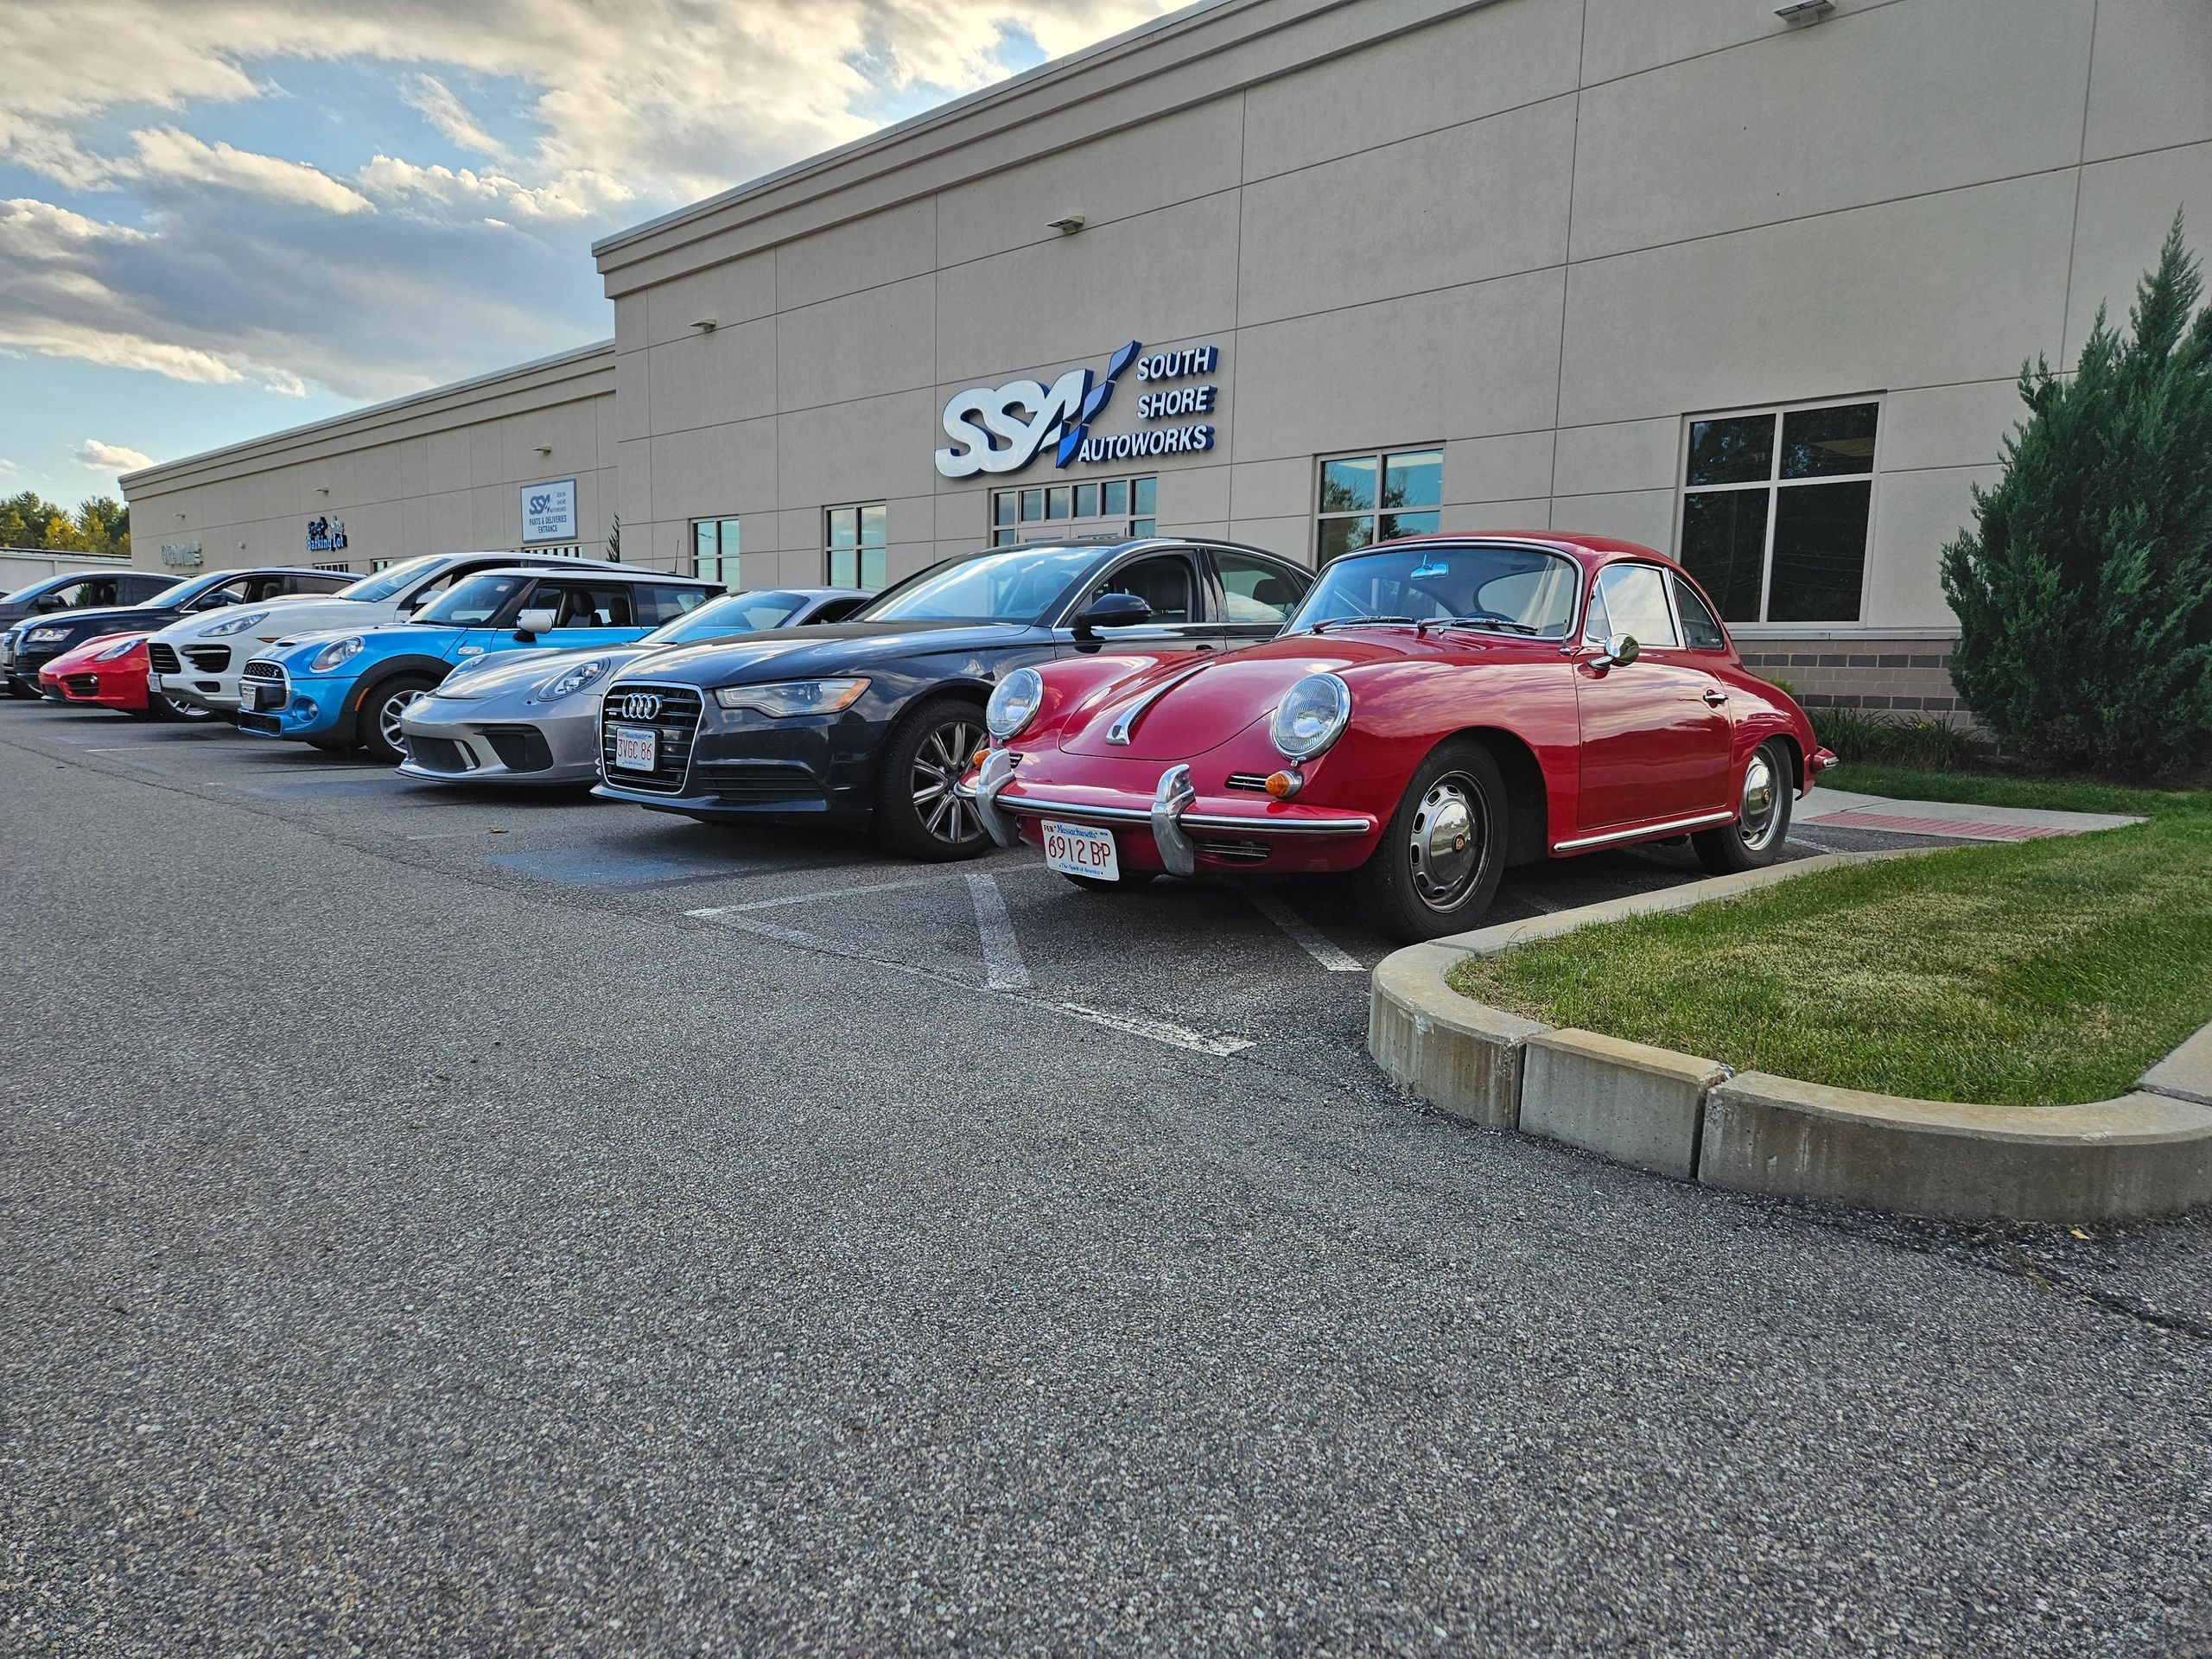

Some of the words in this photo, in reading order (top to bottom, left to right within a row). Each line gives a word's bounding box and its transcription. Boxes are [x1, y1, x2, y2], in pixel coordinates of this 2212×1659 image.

[1136, 346, 1217, 382] SOUTH
[1137, 385, 1217, 420] SHORE
[1077, 424, 1214, 463] AUTOWORKS
[538, 524, 557, 533] ENTRANCE
[545, 515, 567, 524] DELIVERIES
[308, 535, 332, 550] Barking
[333, 533, 344, 549] Lot
[618, 739, 638, 759] 3VGC
[640, 741, 652, 760] 86
[1057, 824, 1096, 838] Massachusetts
[1048, 836, 1087, 864] 6912
[1090, 841, 1110, 867] BP
